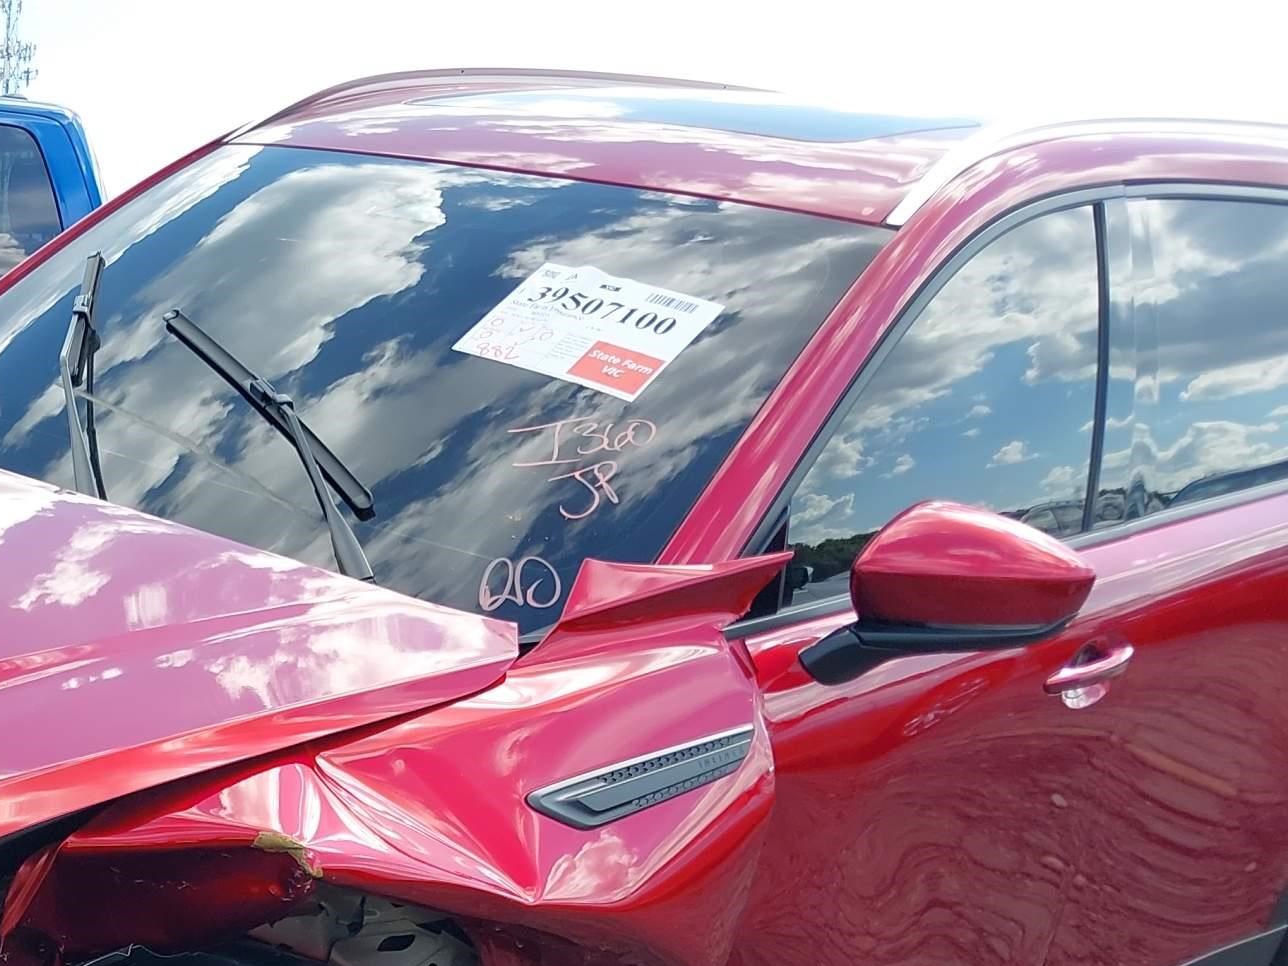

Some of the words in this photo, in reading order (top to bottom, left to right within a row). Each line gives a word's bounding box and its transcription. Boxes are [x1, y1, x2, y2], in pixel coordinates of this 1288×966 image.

[527, 286, 677, 336] 39507100
[588, 349, 621, 364] State
[621, 359, 654, 375] Farm
[601, 364, 624, 378] VIC
